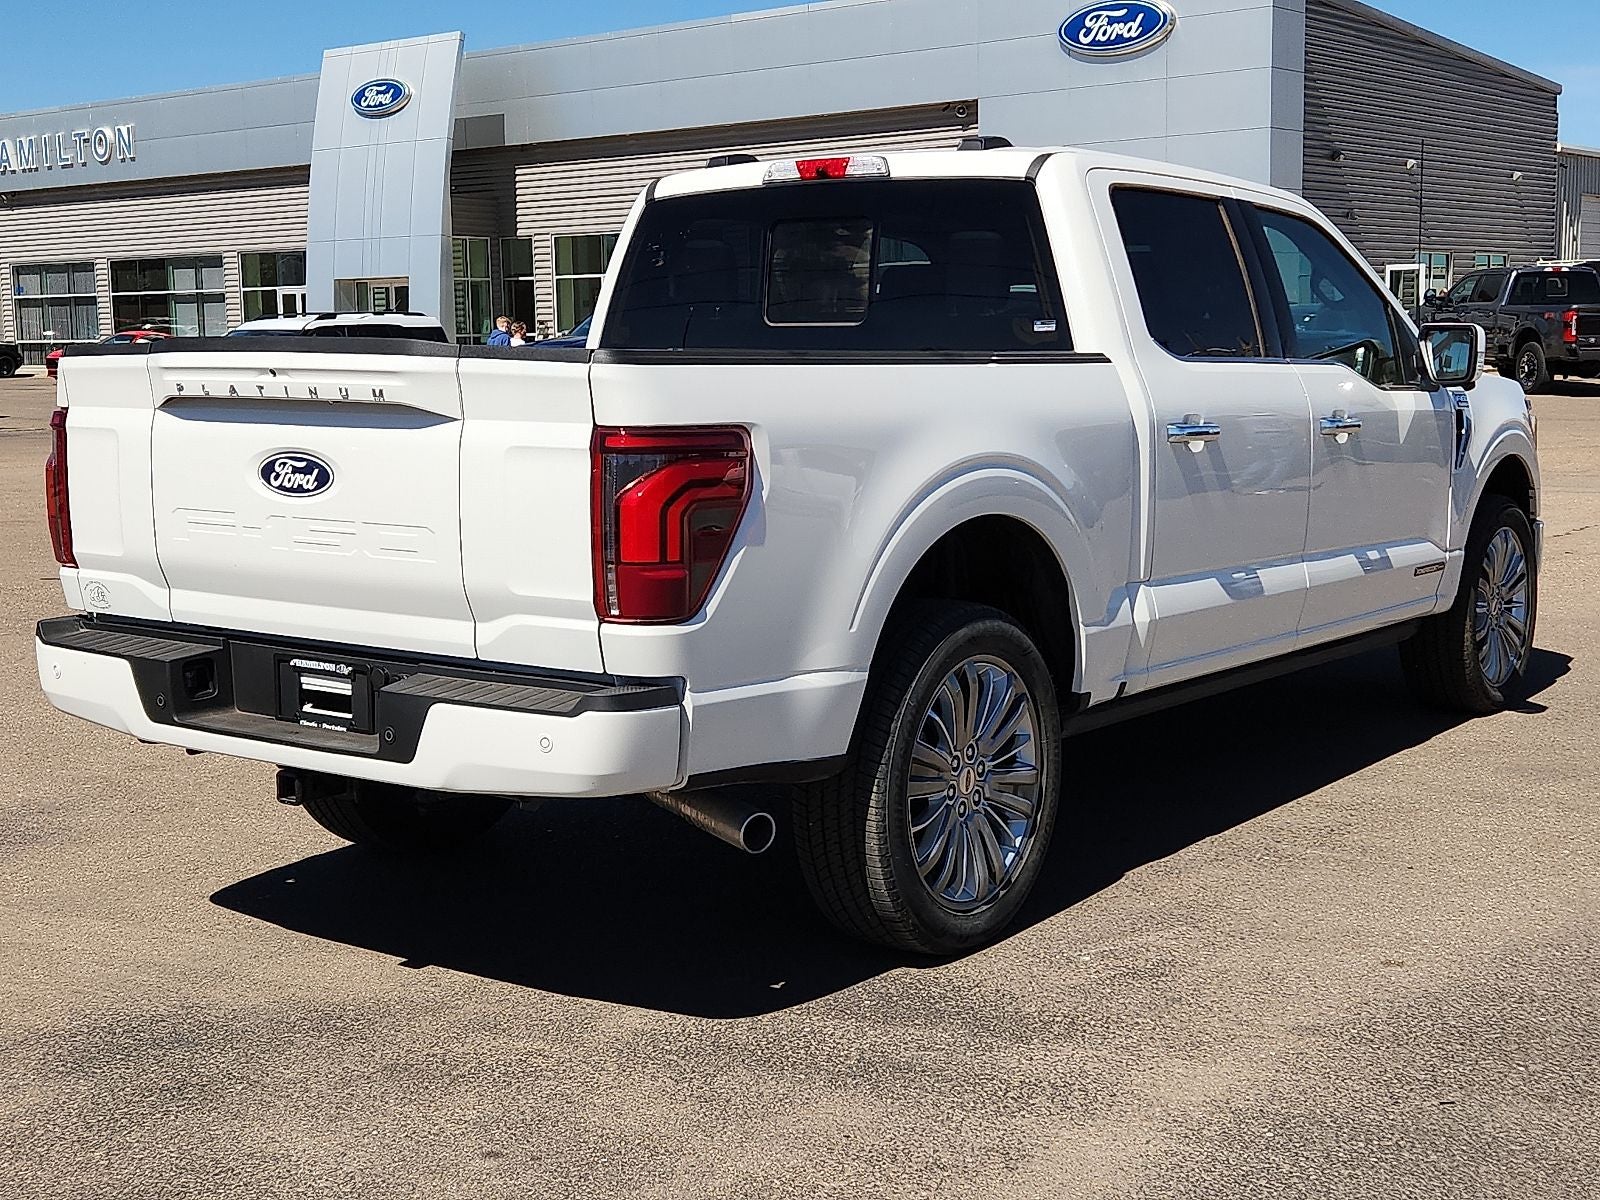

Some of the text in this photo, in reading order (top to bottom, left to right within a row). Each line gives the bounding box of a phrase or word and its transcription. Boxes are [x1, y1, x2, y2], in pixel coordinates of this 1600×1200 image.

[1079, 8, 1145, 44] Ford
[360, 85, 394, 107] Ford
[0, 124, 136, 173] AMILTON
[175, 382, 387, 402] PLATINUM
[270, 458, 318, 490] Ford
